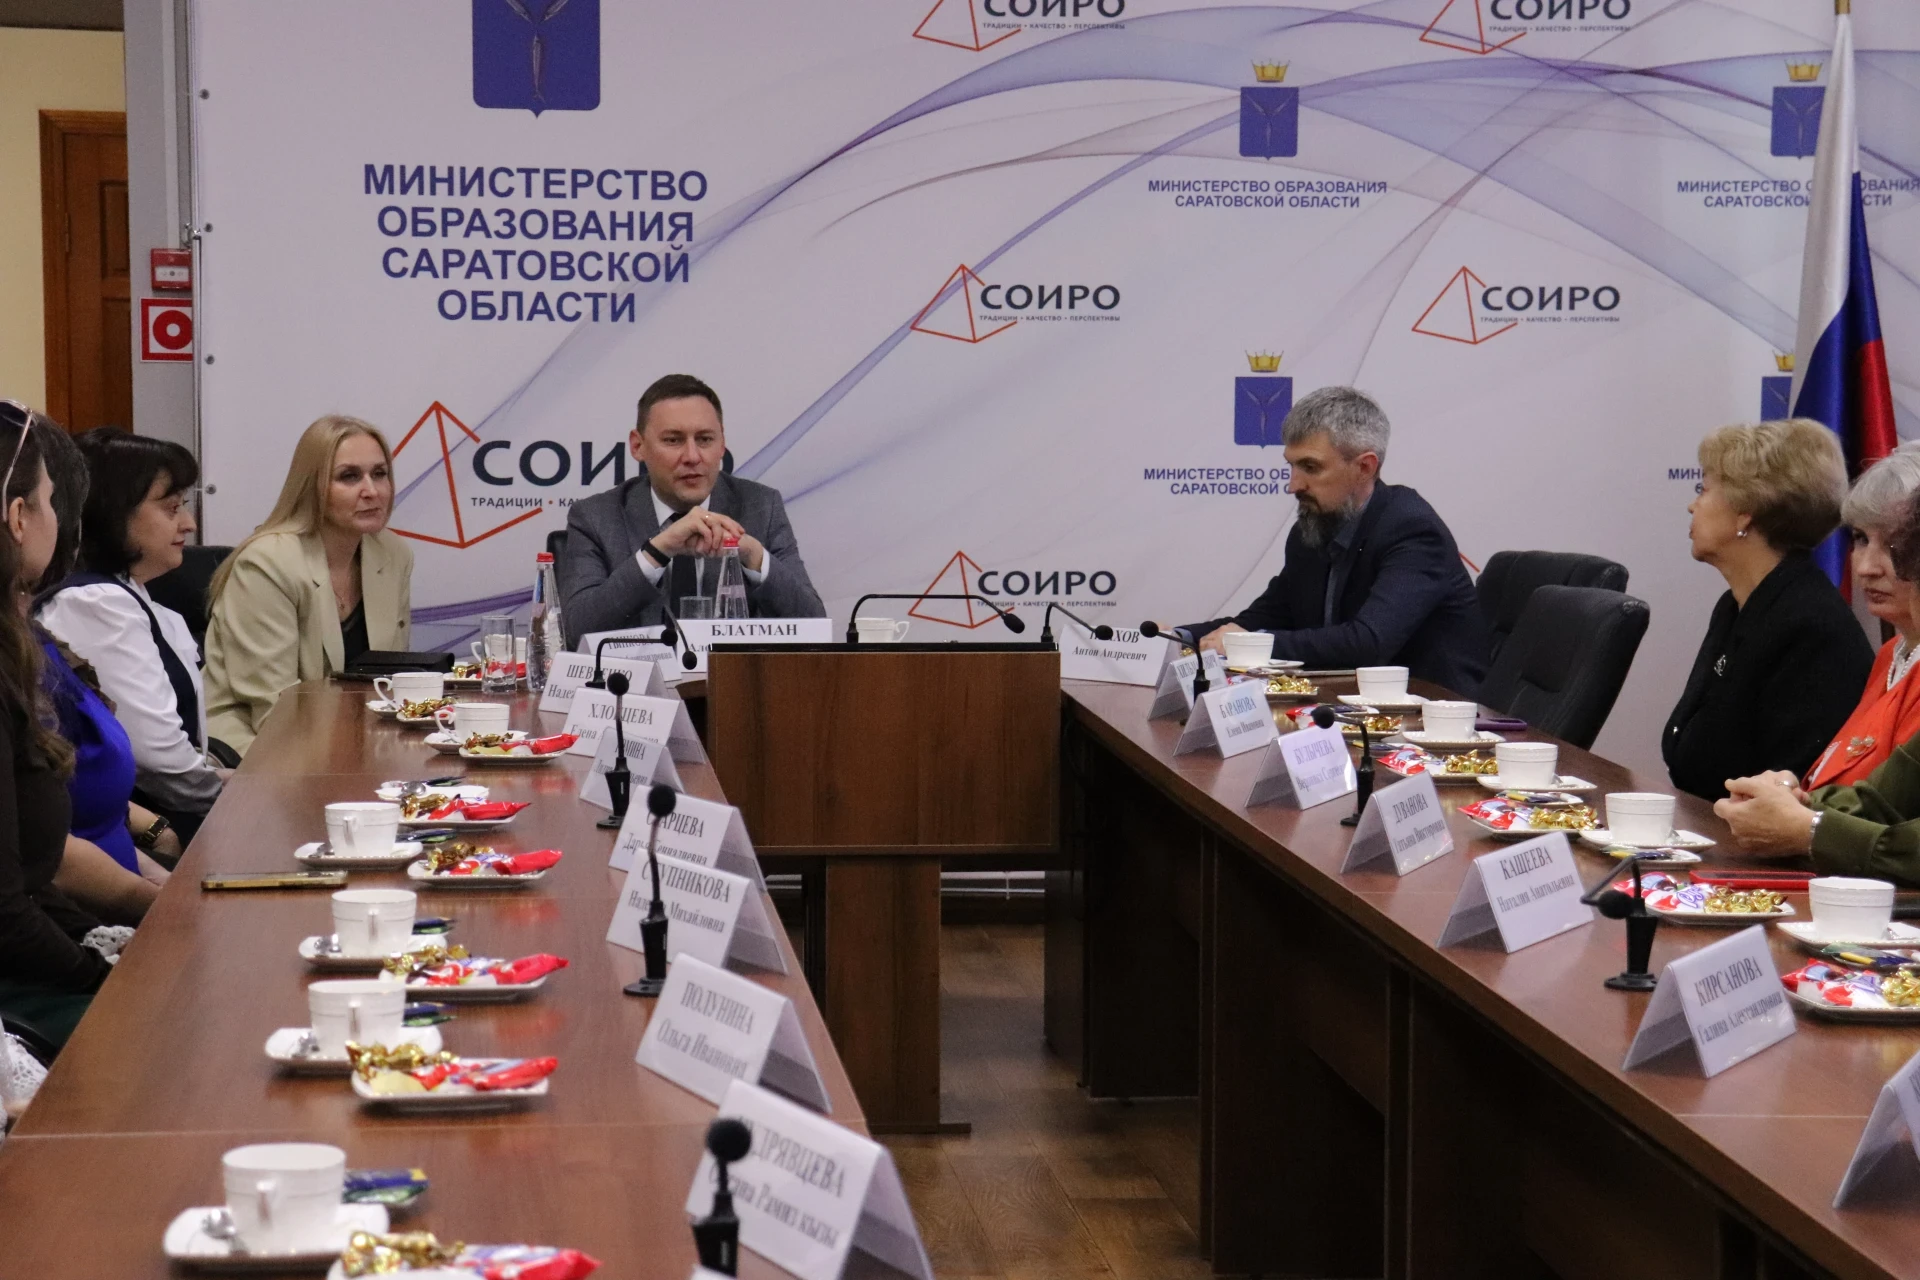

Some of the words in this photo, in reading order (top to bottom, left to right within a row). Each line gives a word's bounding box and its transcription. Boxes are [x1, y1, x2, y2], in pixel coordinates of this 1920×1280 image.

[984, 0, 1125, 17] СОИРО
[1490, 0, 1631, 20] СОИРО
[364, 164, 708, 201] МИНИСТЕРСТВО
[1148, 180, 1270, 192] МИНИСТЕРСТВО
[1274, 181, 1387, 193] ОБРАЗОВАНИЯ
[1677, 180, 1801, 192] МИНИСТЕРСТВО
[1175, 193, 1284, 207] САРАТОВСКОЙ
[1289, 196, 1360, 208] ОБЛАСТИ
[377, 206, 693, 243] ОБРАЗОВАНИЯ
[382, 245, 690, 283] САРАТОВСКОЙ
[437, 290, 636, 323] ОБЛАСТИ
[980, 284, 1120, 310] СОИРО
[1481, 285, 1620, 311] СОИРО
[472, 440, 734, 488] СОИ
[1144, 468, 1265, 480] МИНИСТЕРСТВО
[1170, 481, 1279, 495] САРАТОВСКОЙ
[471, 497, 543, 508] ТРАДИЦИИ
[978, 571, 1117, 596] СОИРО
[711, 624, 797, 636] БЛАТМАН
[1072, 646, 1099, 657] Антон
[1100, 648, 1148, 661] Андреевич
[588, 703, 653, 725] ХЛОЦЕВА
[1219, 696, 1257, 719] БАРАНОВА
[1293, 739, 1335, 764] БУЛЫЧЕВА
[1392, 793, 1428, 825] ДУВАНОВА
[646, 811, 705, 838] САРЦЕВА
[1499, 845, 1553, 880] КАЩЕЕВА
[641, 861, 730, 903] СУПНИКОВА
[1529, 873, 1575, 904] Анатольевна
[669, 901, 726, 933] Михайловна
[1694, 956, 1763, 1007] КИРСАНОВА
[680, 980, 756, 1035] ПОЛУНИНА
[656, 1018, 692, 1054] Ольга
[689, 1032, 750, 1079] Ивановна
